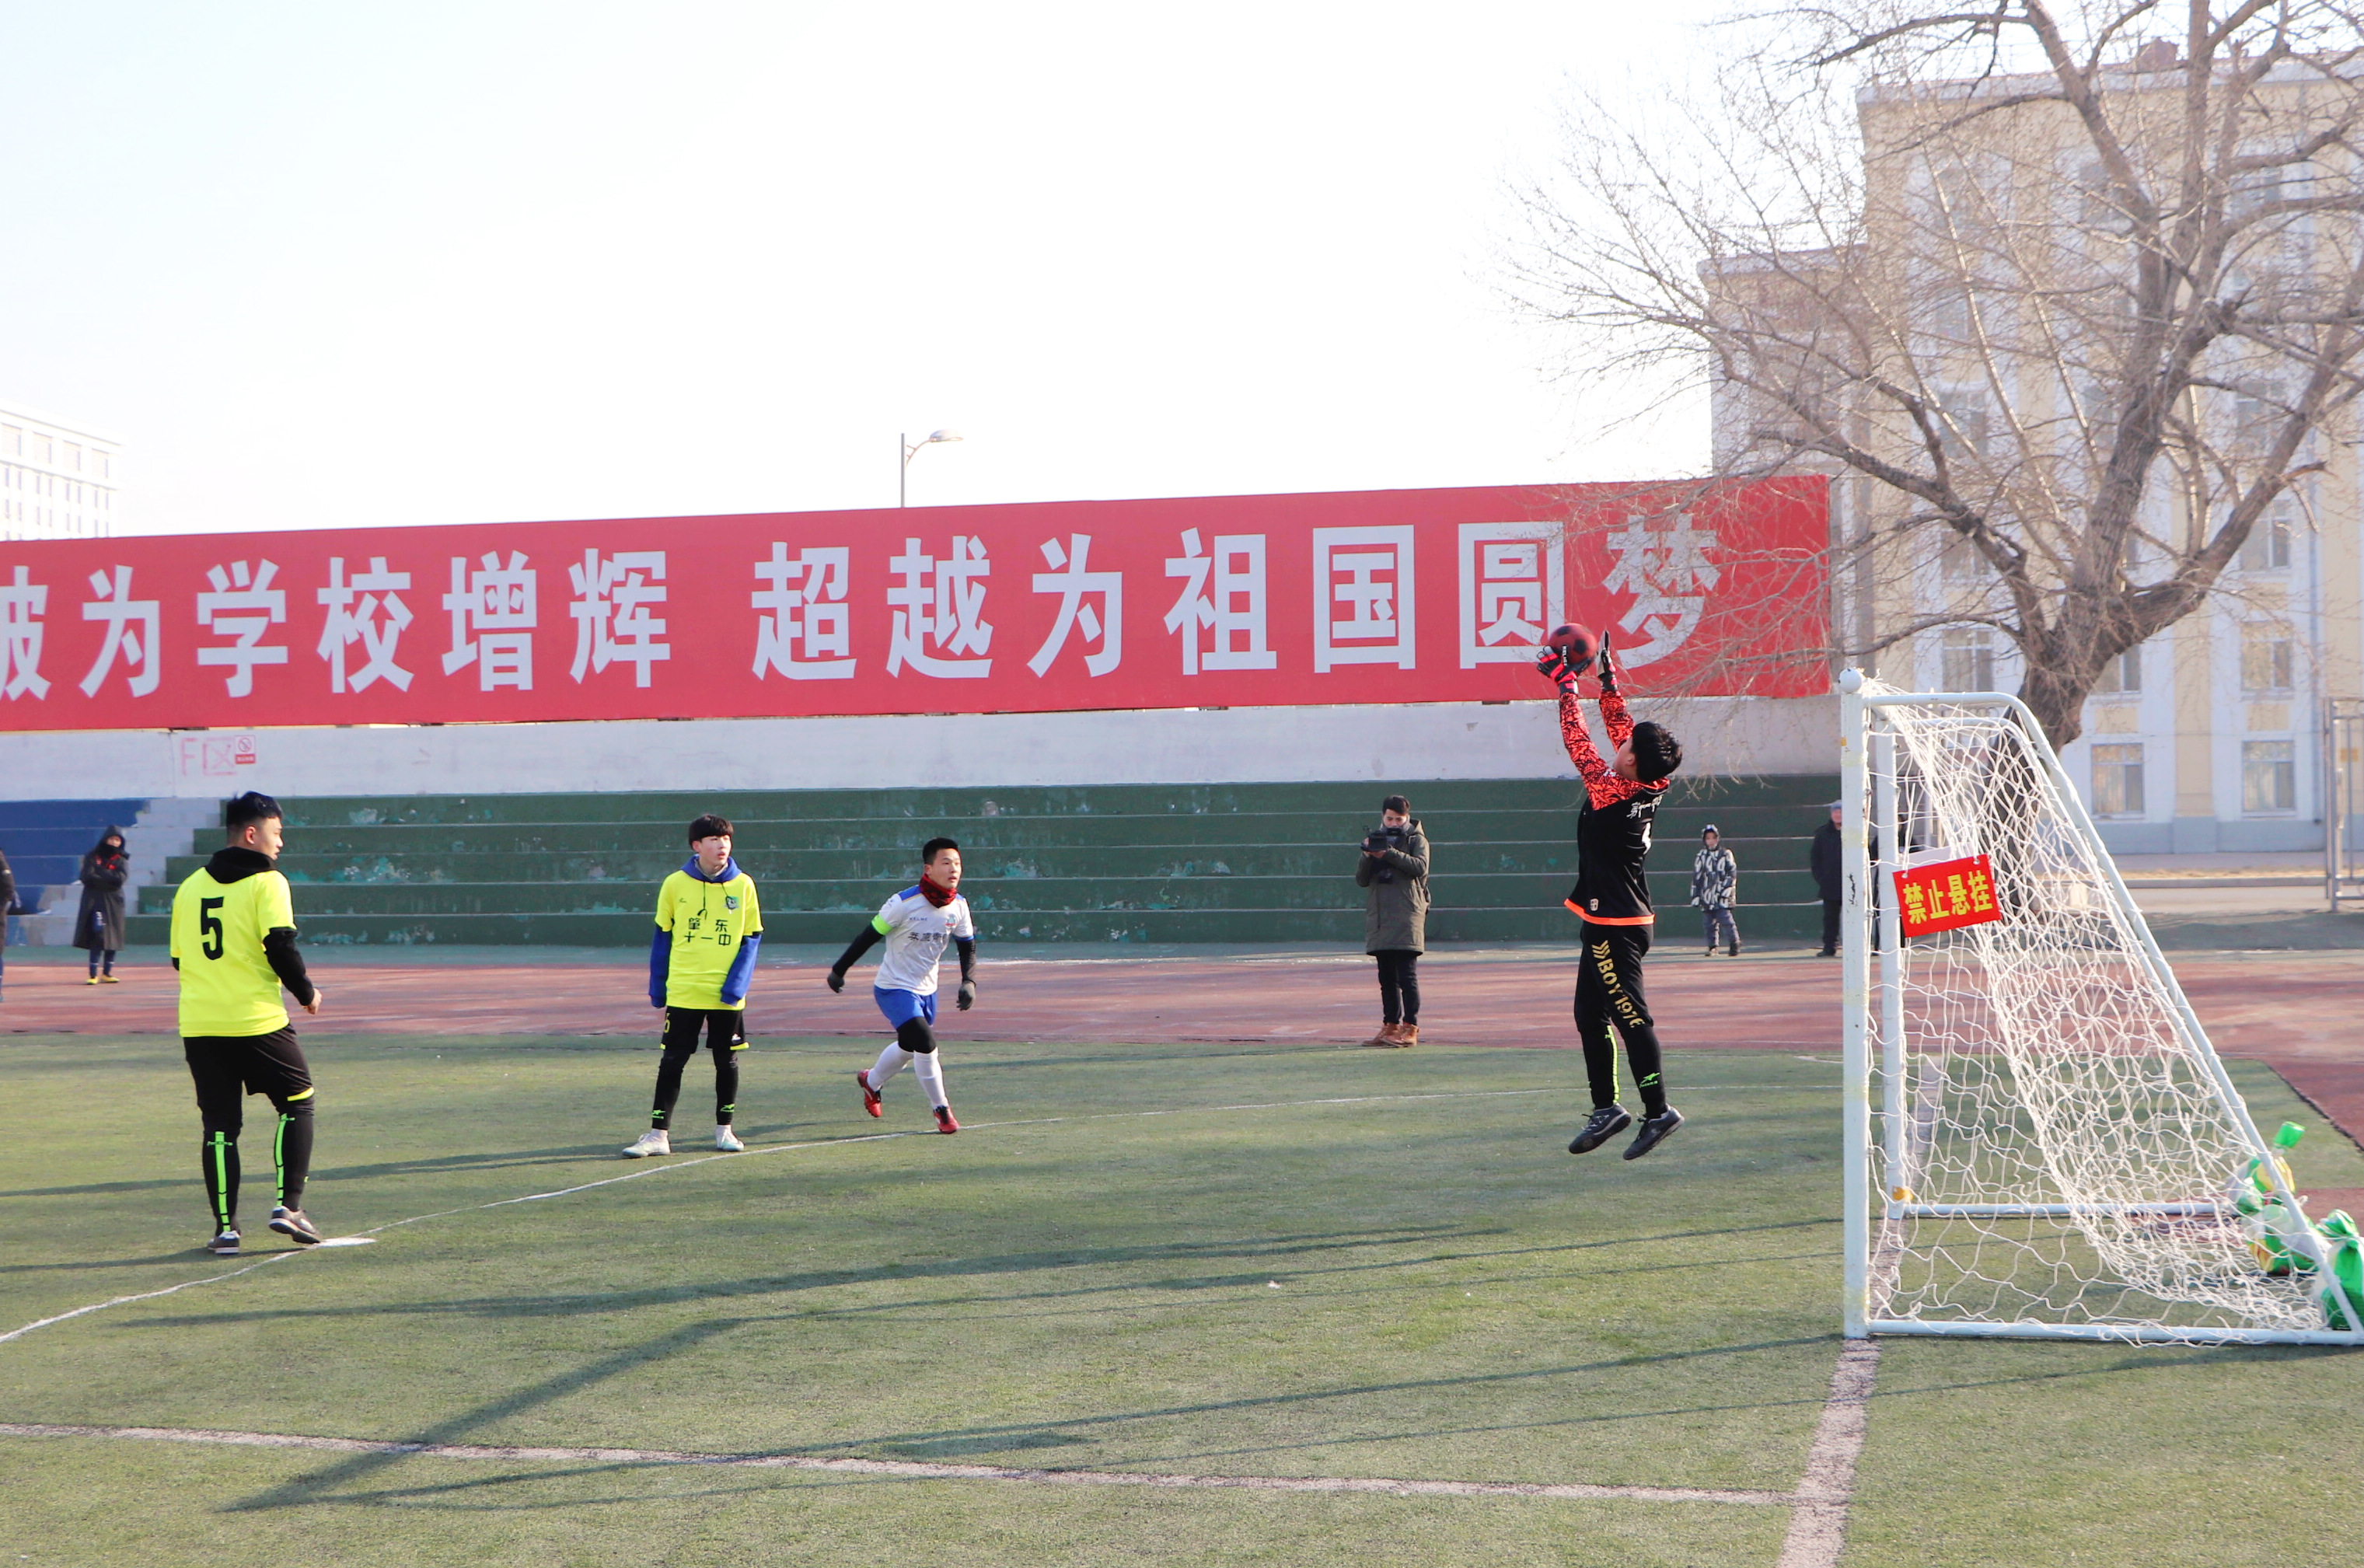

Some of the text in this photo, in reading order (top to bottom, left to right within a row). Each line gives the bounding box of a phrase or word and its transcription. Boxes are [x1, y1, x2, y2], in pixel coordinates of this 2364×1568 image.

[751, 513, 1723, 680] 超越为祖国圆梦
[1903, 869, 1993, 924] 禁止悬挂
[201, 897, 225, 960] 5
[684, 931, 731, 946] 十一中
